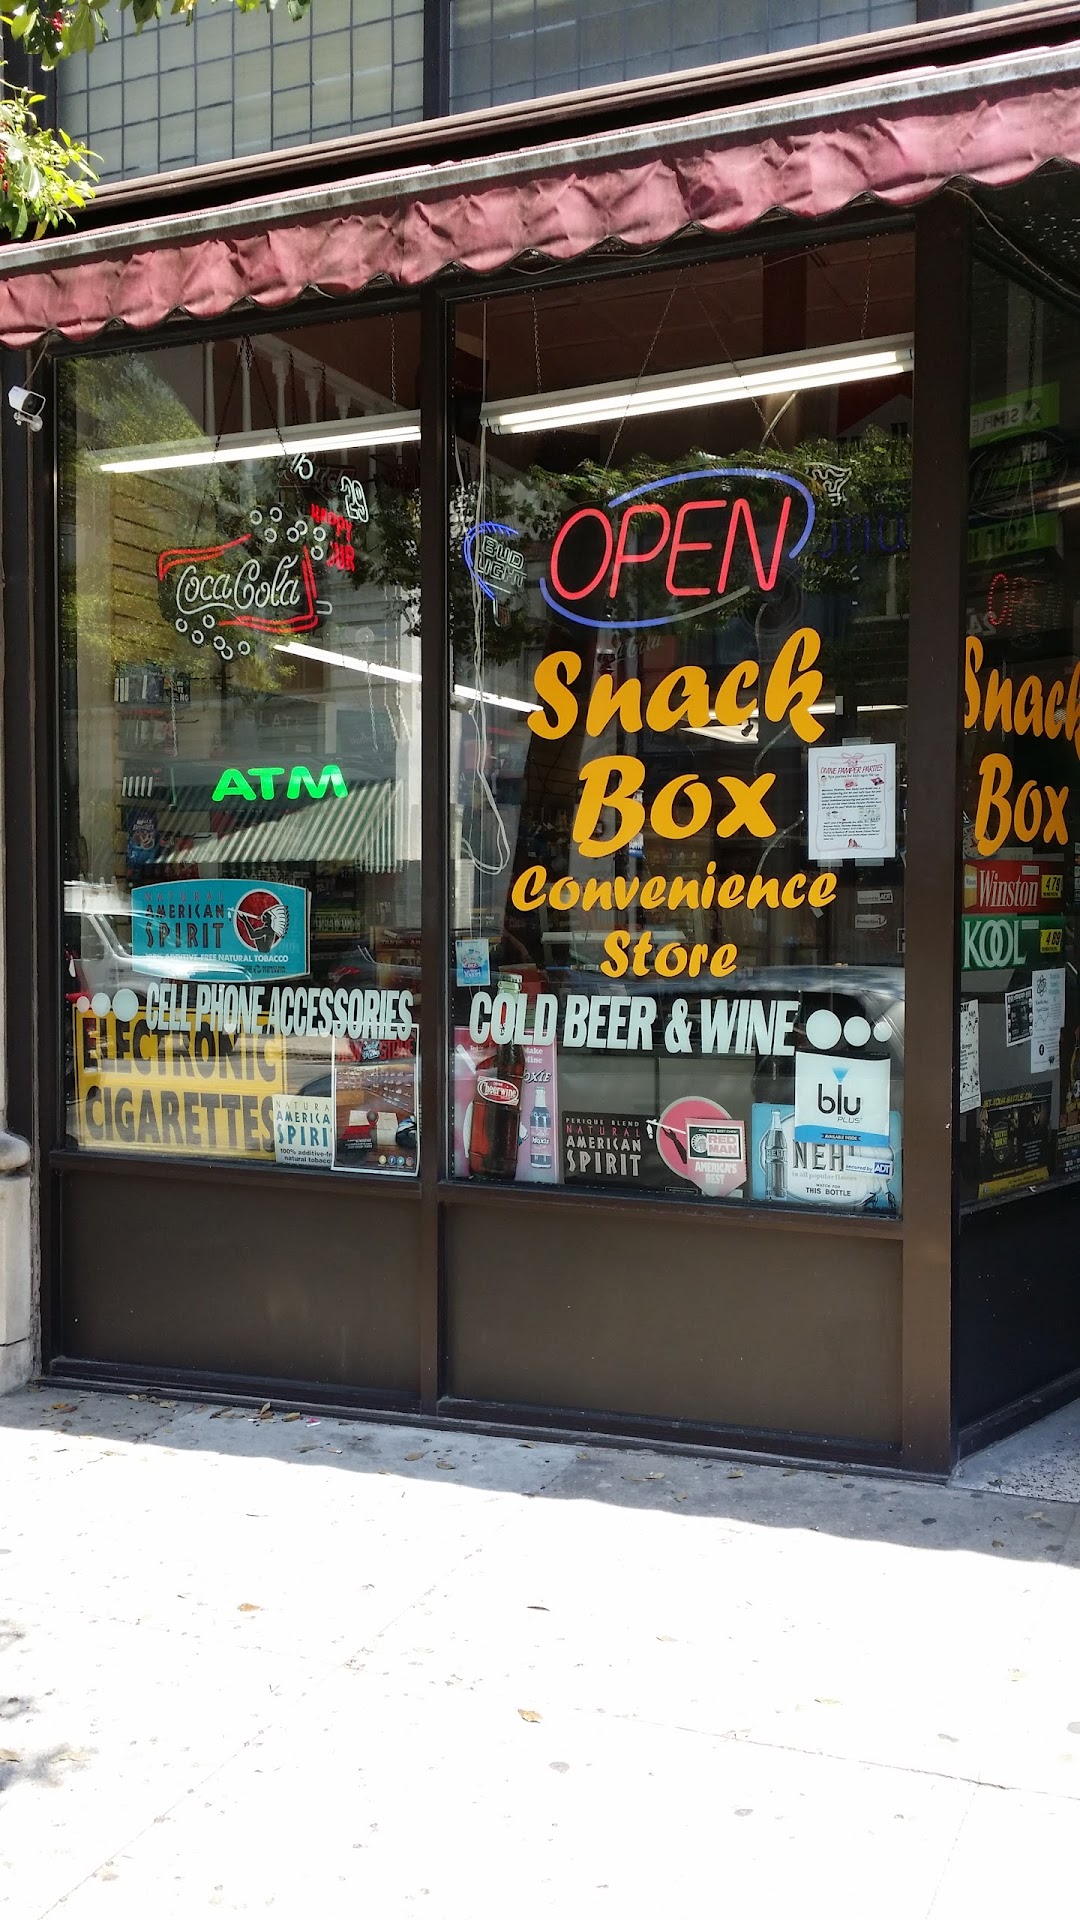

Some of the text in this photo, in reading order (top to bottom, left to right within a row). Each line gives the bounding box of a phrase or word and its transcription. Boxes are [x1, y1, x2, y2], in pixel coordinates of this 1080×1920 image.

[482, 535, 524, 569] BUD
[550, 496, 792, 600] OPEN
[477, 552, 527, 588] LIGHT
[527, 627, 826, 743] Snack
[212, 765, 348, 801] ATM
[572, 755, 777, 858] Box
[975, 753, 1069, 856] Box
[145, 890, 224, 901] NATURAL
[511, 861, 838, 912] Convenience
[979, 869, 1039, 908] Winston
[145, 904, 225, 919] AMERICAN
[145, 922, 225, 949] SPIRIT
[963, 919, 1028, 969] KOOL
[218, 954, 253, 962] NATURAL
[253, 954, 289, 963] TOBACCO
[600, 930, 738, 978] Store
[146, 982, 413, 1041] CELL PHONE ACCESSORIES
[469, 991, 801, 1056] COLD BEER & WINE
[83, 1016, 277, 1082] ELECTRONIC
[480, 1081, 517, 1099] Cheerwine
[818, 1084, 861, 1115] blu
[86, 1085, 276, 1153] CIGARETTES
[565, 1118, 604, 1126] PERIQUE
[566, 1125, 641, 1138] NATURAL
[837, 1116, 861, 1124] PLUS
[278, 1125, 333, 1148] SPIRI
[566, 1136, 641, 1152] AMERICAN
[708, 1135, 737, 1144] RED
[708, 1144, 737, 1154] MAN
[566, 1149, 642, 1177] SPIRIT
[695, 1161, 737, 1174] AMERICA'S
[809, 1172, 834, 1180] popular
[874, 1164, 890, 1174] ADT
[705, 1174, 725, 1185] BEST
[825, 1188, 852, 1197] BOTTLE
